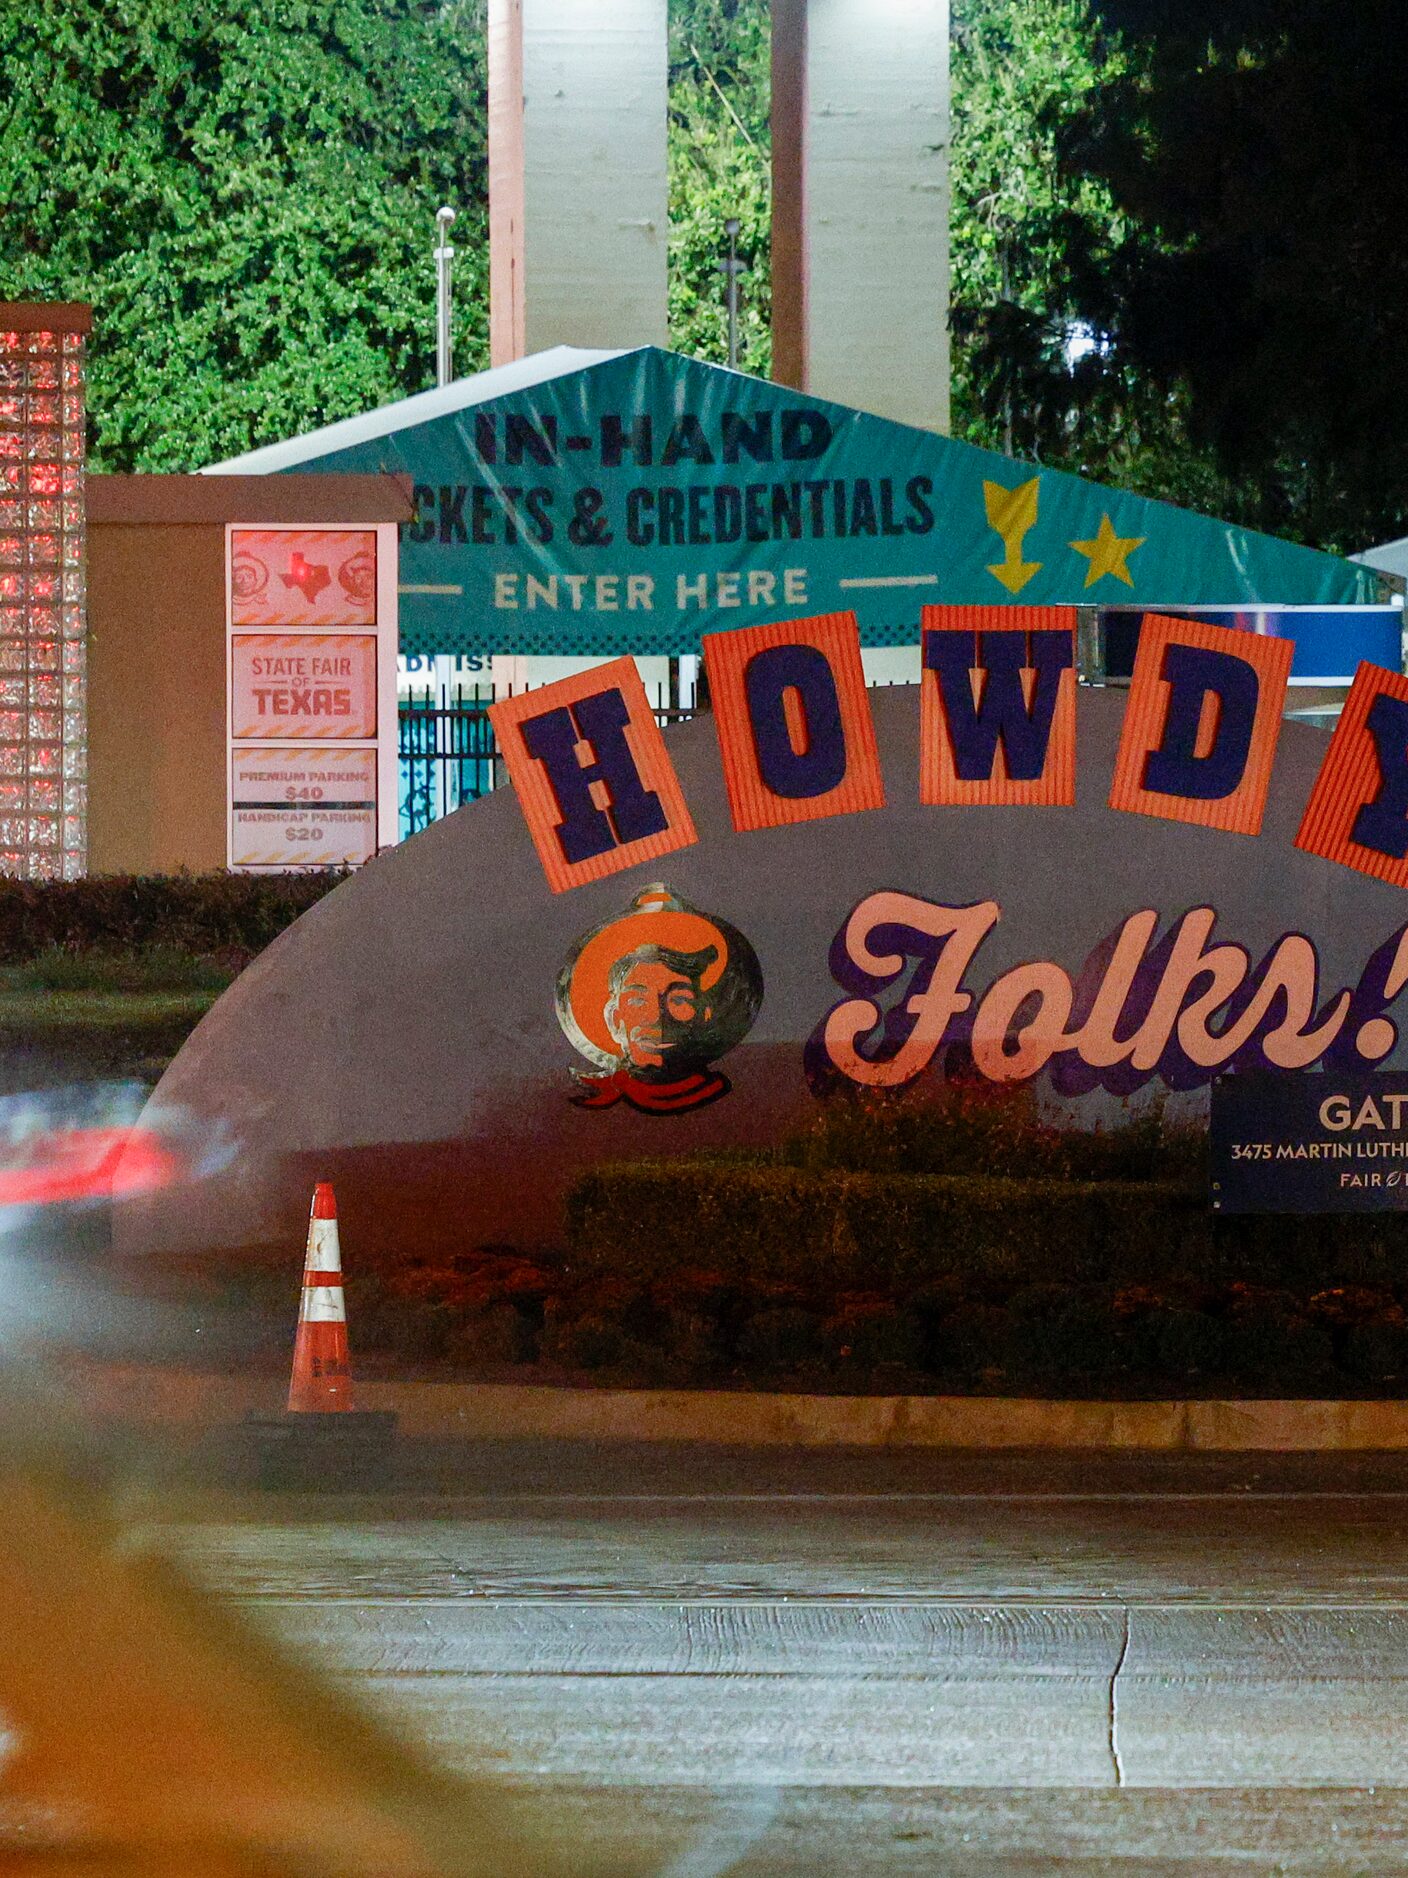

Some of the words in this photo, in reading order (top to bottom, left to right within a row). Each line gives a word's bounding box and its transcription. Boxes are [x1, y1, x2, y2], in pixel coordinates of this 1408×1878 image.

[475, 409, 834, 467] IN-HAND
[399, 485, 554, 546] CKETS
[567, 484, 614, 547] &
[626, 474, 935, 546] CREDENTIALS
[494, 573, 656, 610] ENTER
[676, 568, 809, 609] HERE
[252, 658, 307, 675] STATE
[312, 658, 351, 675] FAIR
[292, 677, 310, 687] OF
[251, 688, 351, 716] TEXAS
[239, 771, 306, 782] PREMIUM
[309, 771, 370, 782] PARKING
[285, 786, 324, 801] $40
[238, 812, 308, 823] HANDICAP
[311, 812, 371, 823] PARKING
[285, 827, 324, 842] $20
[1231, 1144, 1272, 1160] 3475
[1276, 1142, 1352, 1159] MARTIN
[1340, 1172, 1382, 1187] FAIR
